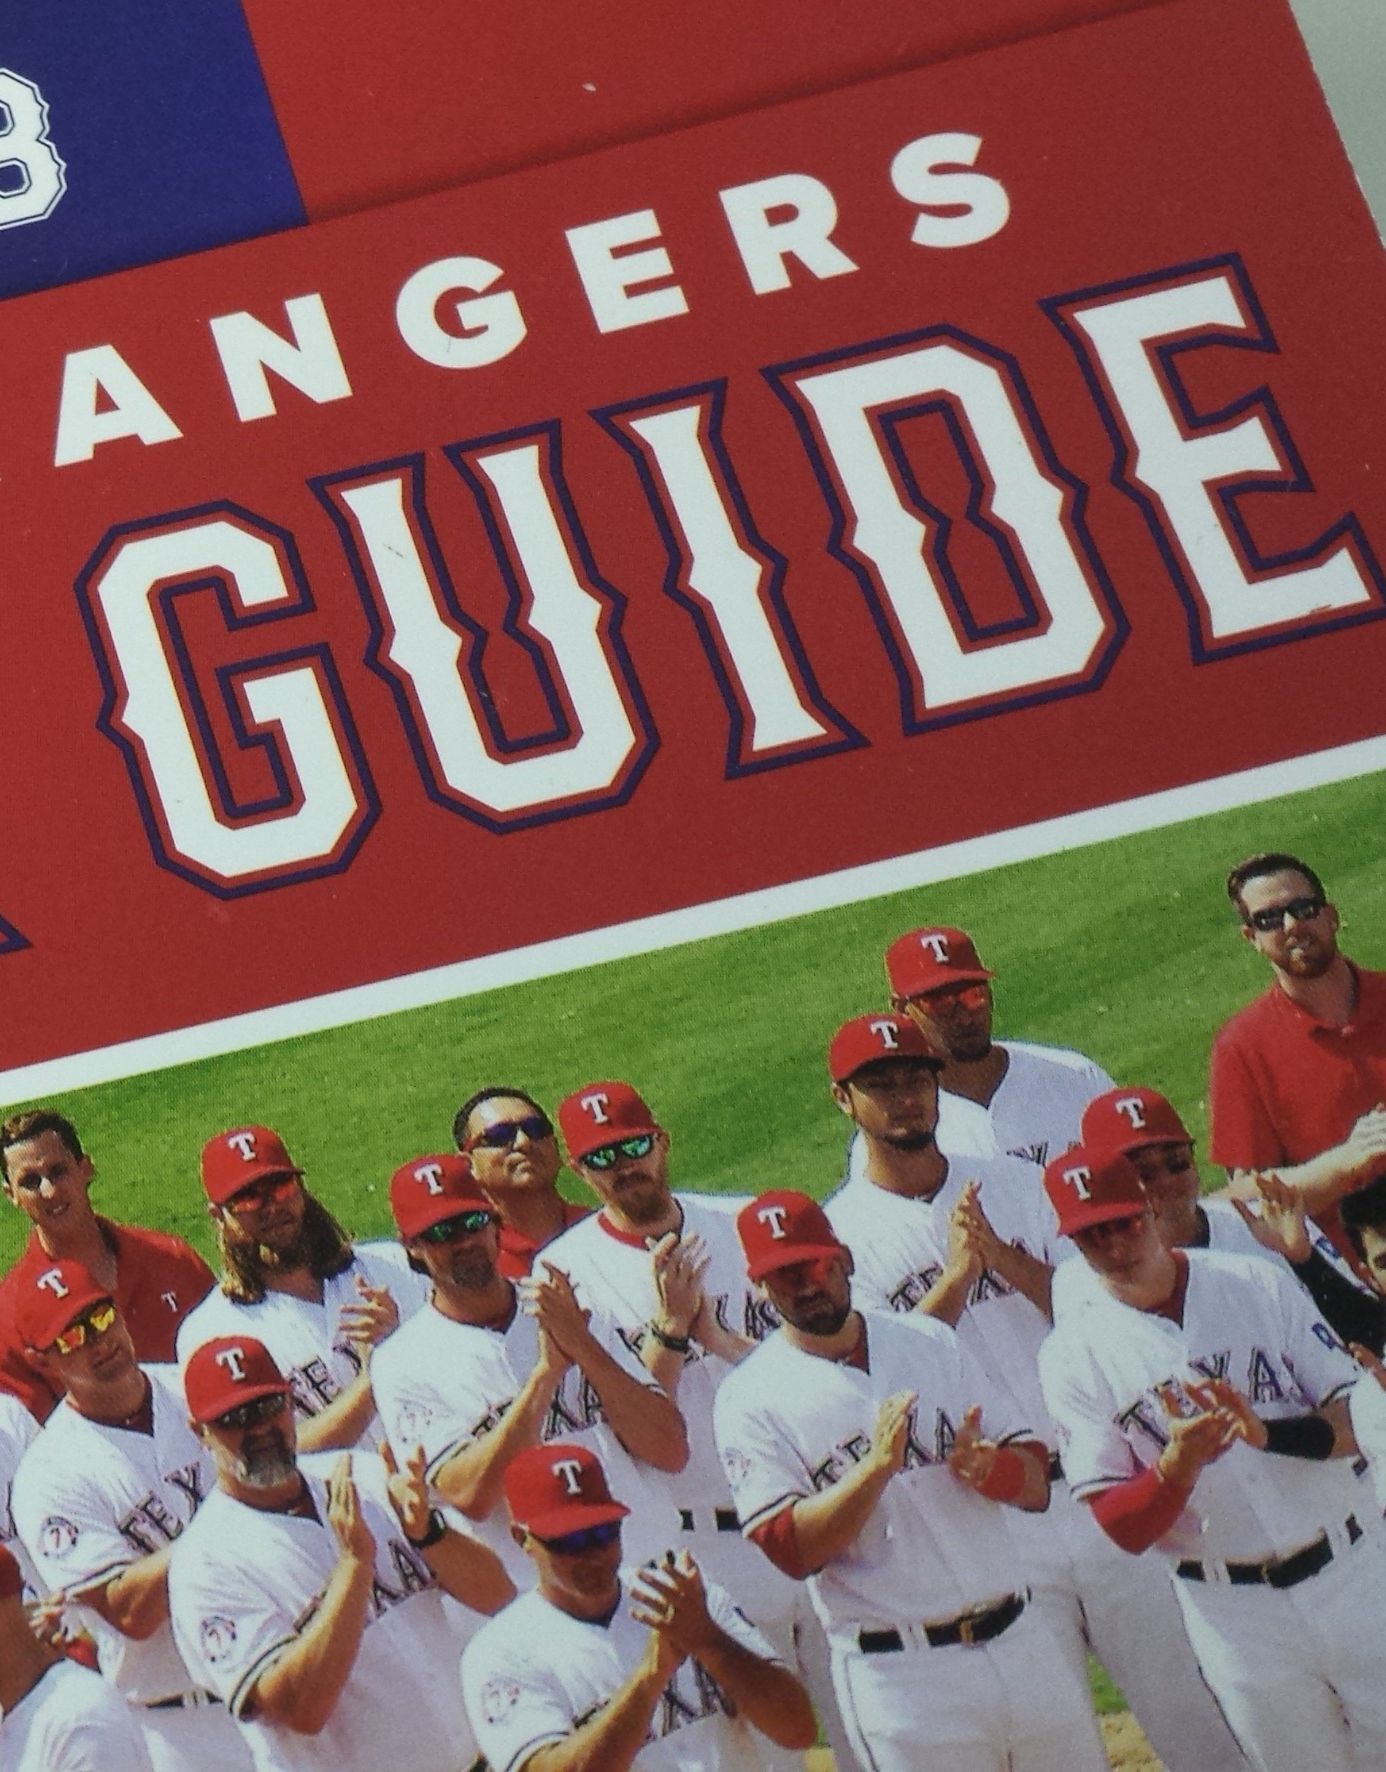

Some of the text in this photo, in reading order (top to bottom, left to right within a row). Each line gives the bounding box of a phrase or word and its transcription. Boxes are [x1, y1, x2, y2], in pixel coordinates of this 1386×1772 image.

[88, 252, 1386, 897] GUIDE
[920, 932, 950, 963] T
[870, 1019, 899, 1049] T
[580, 1091, 610, 1124] T
[1114, 1096, 1145, 1129] T
[227, 1131, 257, 1162] T
[413, 1162, 444, 1195] T
[1062, 1165, 1092, 1200] T
[757, 1205, 787, 1240] T
[36, 1268, 69, 1298] T
[161, 1291, 178, 1312] T
[215, 1346, 246, 1382] T
[551, 1458, 583, 1494] T
